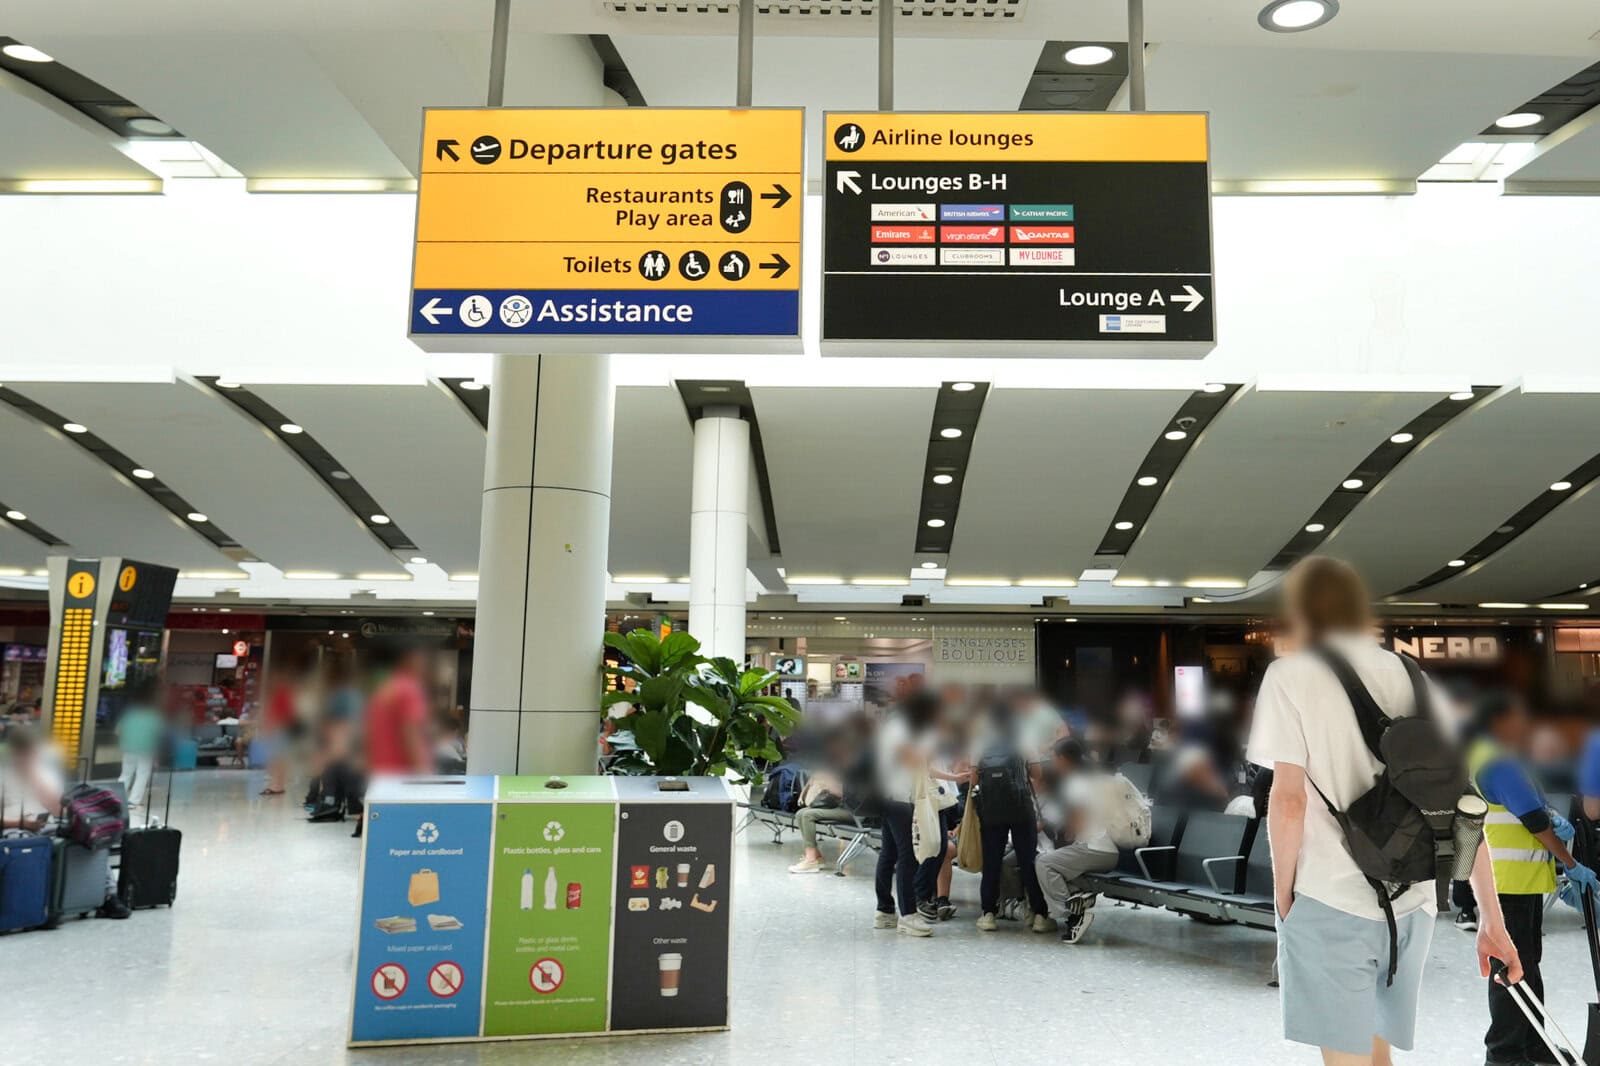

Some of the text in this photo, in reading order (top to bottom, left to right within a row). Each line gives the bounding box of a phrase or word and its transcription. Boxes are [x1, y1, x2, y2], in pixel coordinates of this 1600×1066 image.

[872, 129, 1034, 150] Airline lounges
[510, 139, 738, 165] Departure gates
[872, 173, 1007, 194] Lounges B-H
[586, 188, 714, 204] Restaurants
[616, 210, 712, 230] Play area
[876, 230, 910, 238] Emirates
[564, 256, 632, 274] Toilets
[1020, 251, 1064, 260] MY LOUNGE
[1060, 288, 1166, 310] Lounge A
[538, 299, 693, 323] Assistance
[942, 639, 1026, 648] SUNGLASSES
[1393, 636, 1498, 659] NERO
[942, 649, 1026, 662] BOUTIQUE
